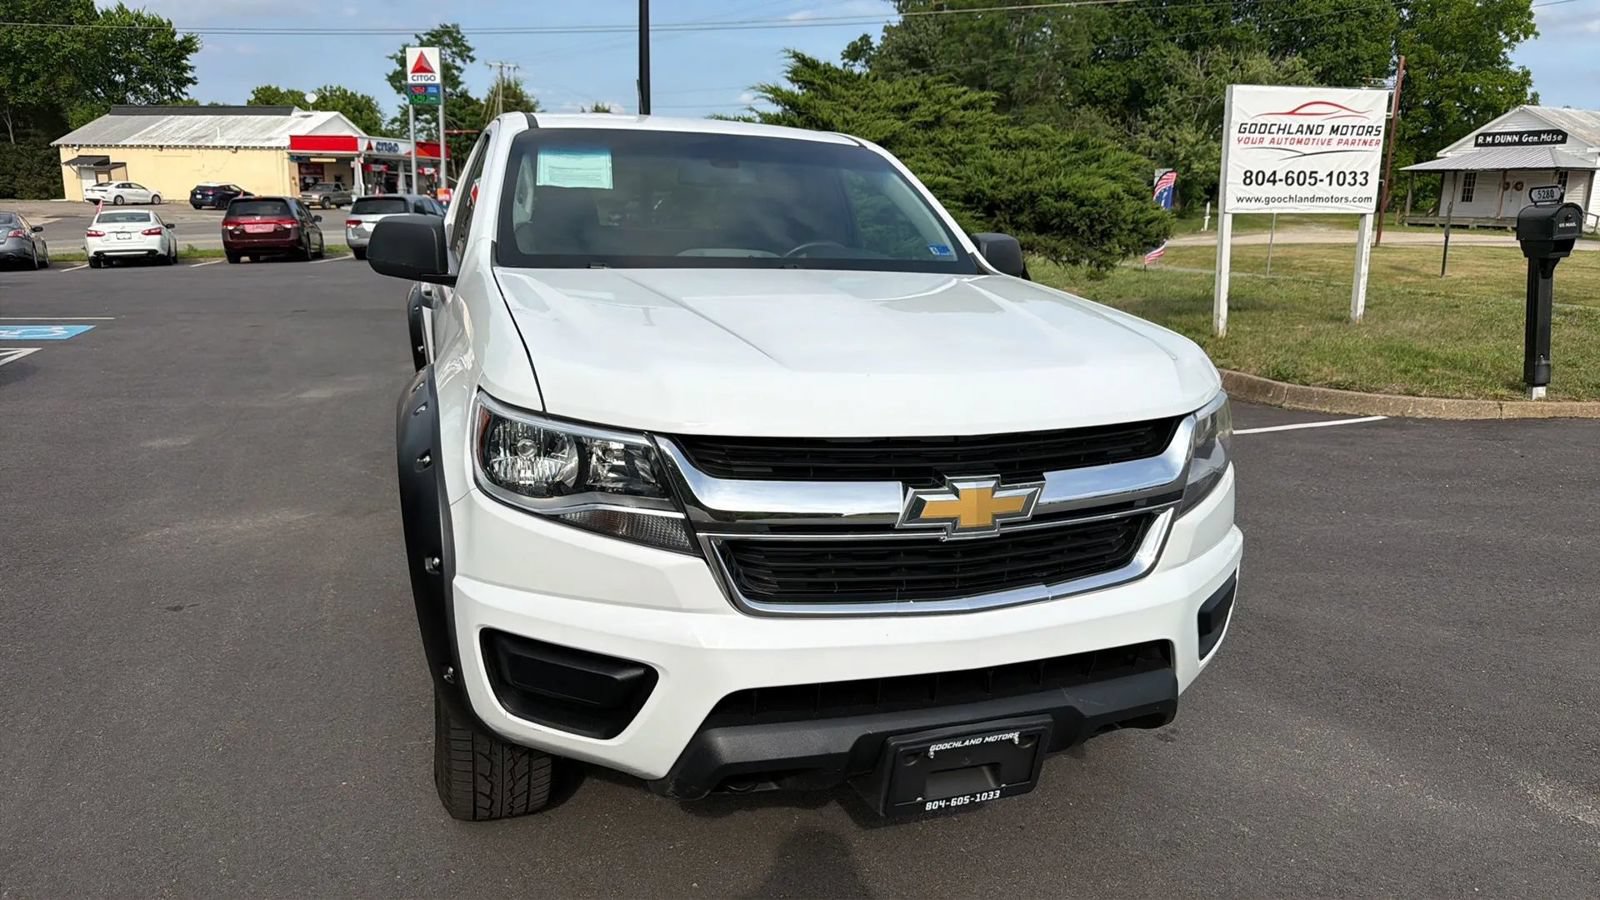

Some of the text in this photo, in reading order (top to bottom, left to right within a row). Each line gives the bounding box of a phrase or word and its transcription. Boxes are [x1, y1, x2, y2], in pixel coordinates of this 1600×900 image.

[1238, 122, 1382, 136] GOOCHLAND MOTORS
[1237, 137, 1381, 147] YOUR AUTOMOTIVE PARTNER
[1494, 134, 1520, 144] DUNN
[1242, 170, 1369, 187] 804-605-1033
[1236, 194, 1372, 205] www.goochlandmotors.com
[1537, 189, 1554, 199] 5280
[929, 732, 1020, 752] GOOCHLAND MOTORS
[925, 790, 1000, 810] 804-605-1033
